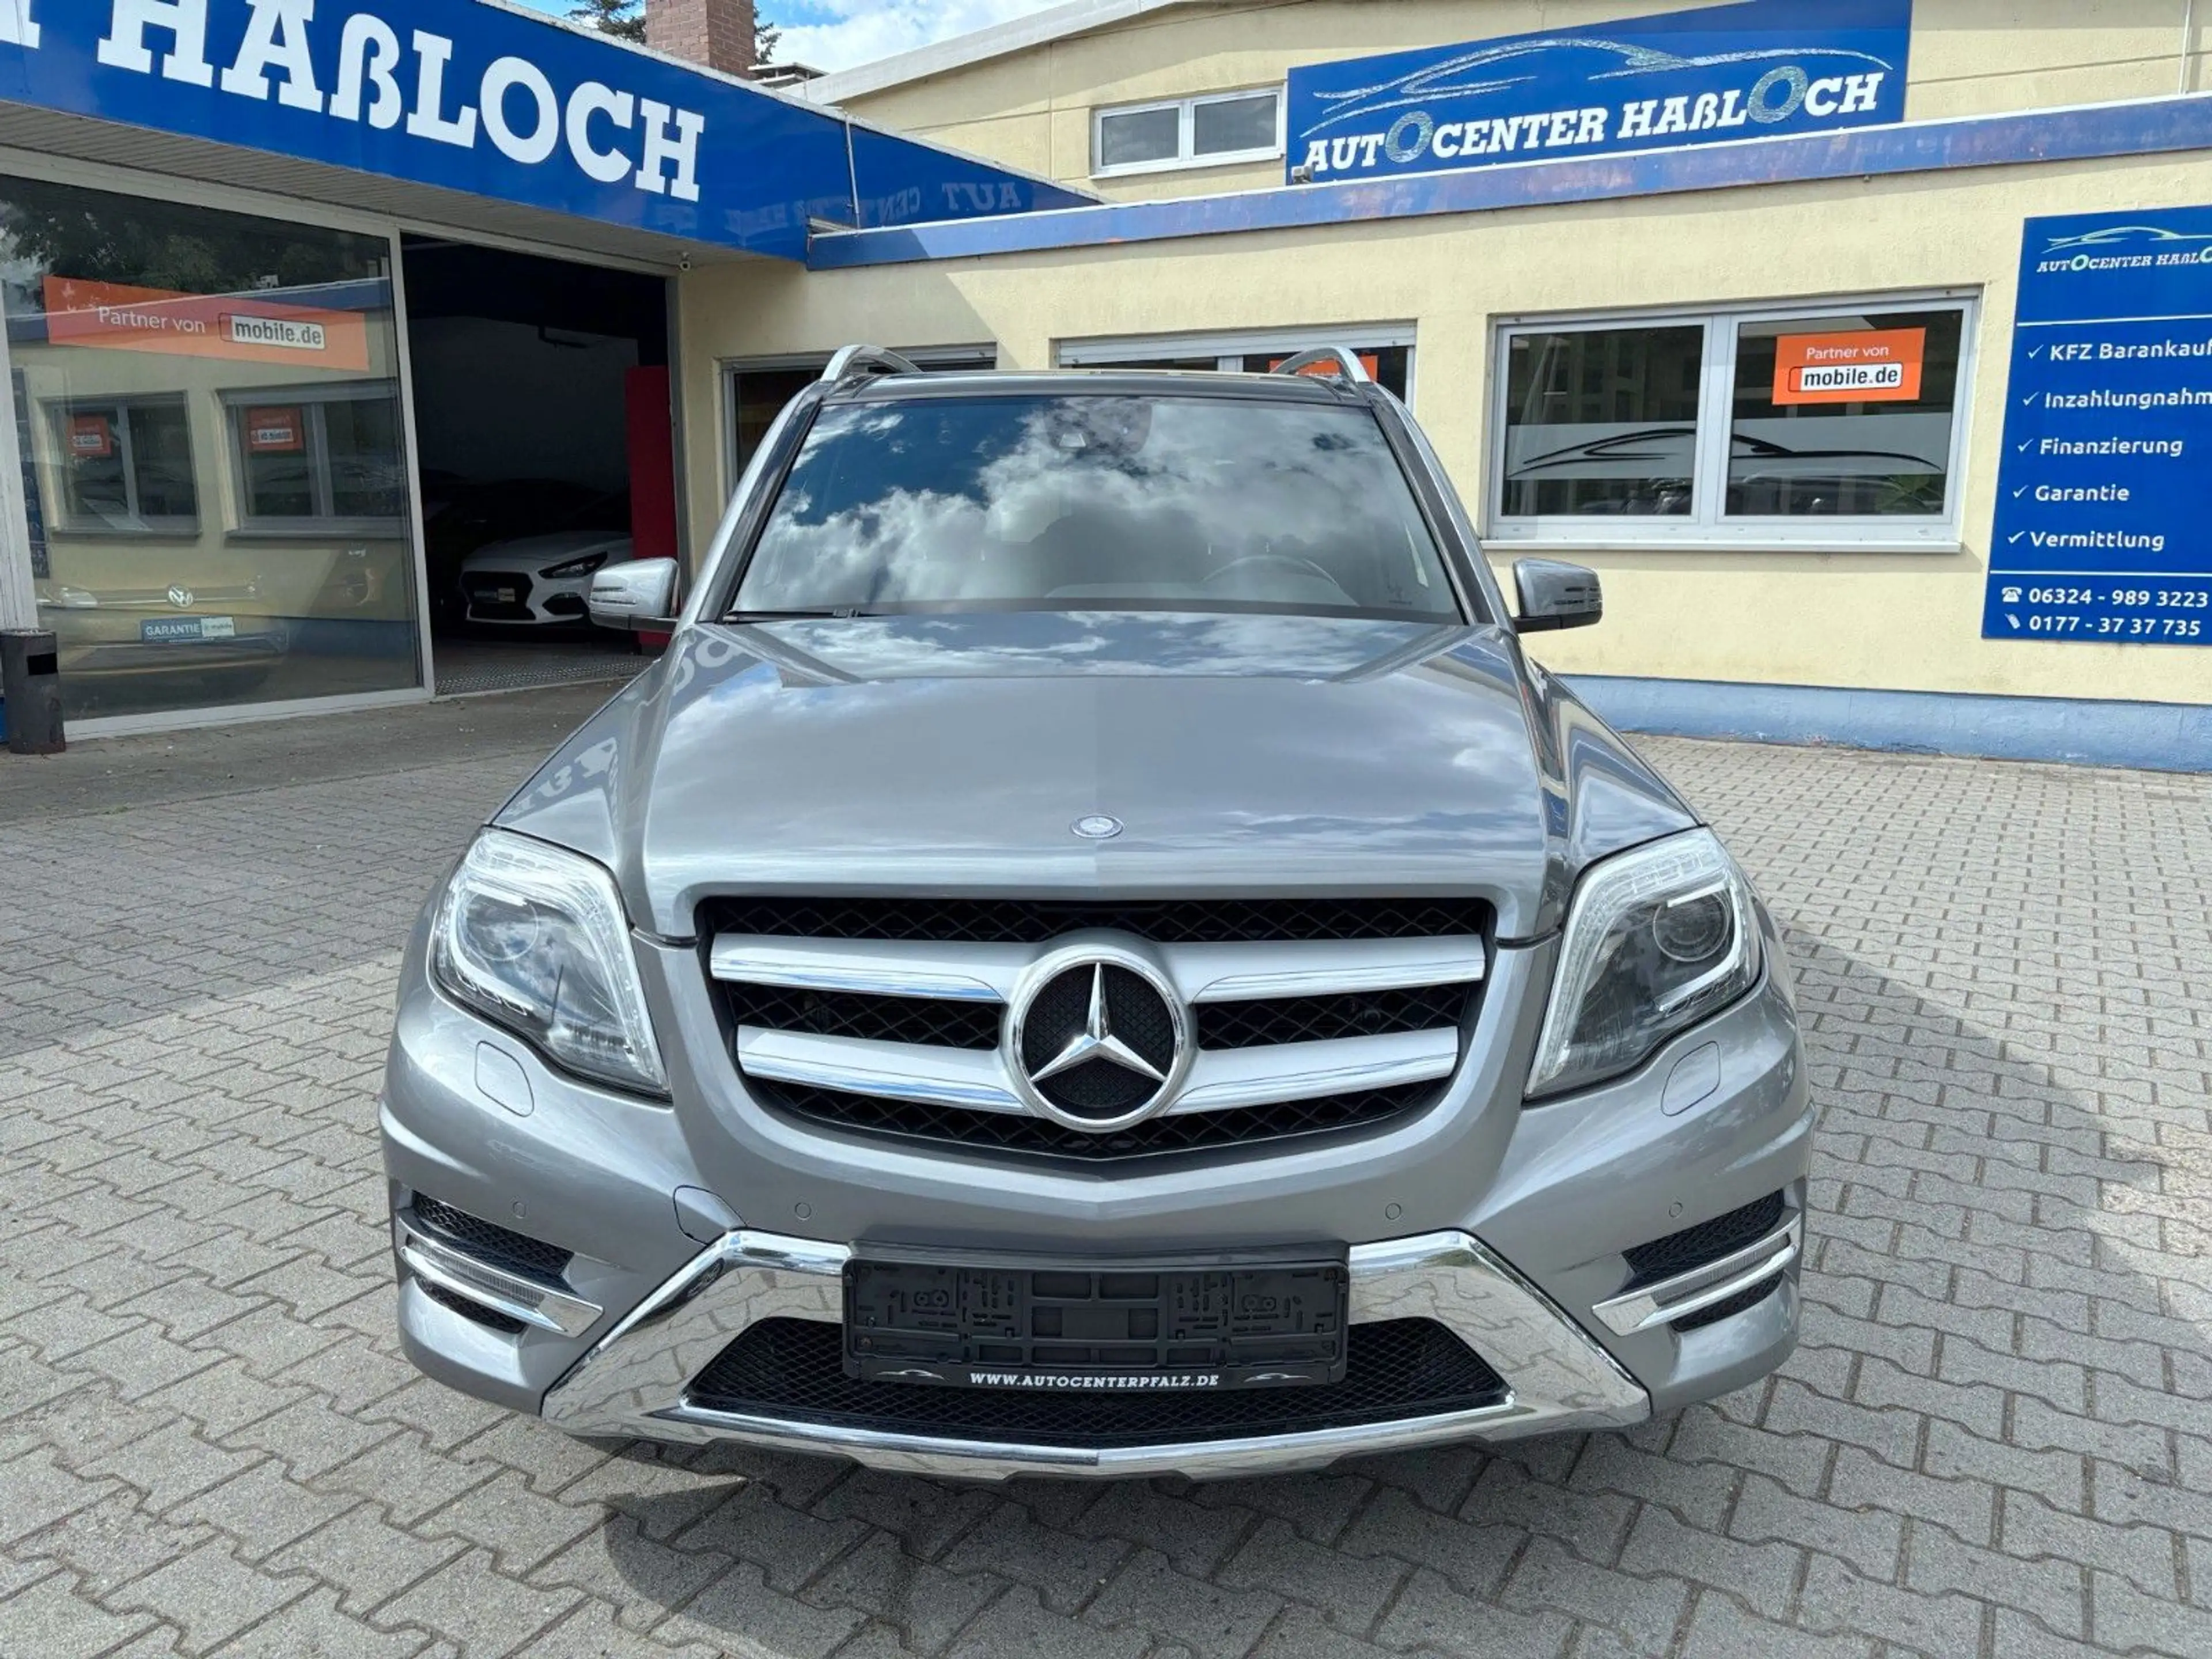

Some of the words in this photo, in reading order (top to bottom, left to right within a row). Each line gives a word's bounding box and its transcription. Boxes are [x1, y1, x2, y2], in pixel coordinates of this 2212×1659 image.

[1304, 111, 1608, 172] AUTOCENTER
[1616, 66, 1884, 139] HAßLOCH
[2036, 254, 2152, 273] AUTOCENTER
[99, 306, 168, 329] Partner
[172, 318, 206, 333] von
[235, 321, 322, 345] mobile.de
[1806, 347, 1859, 360] Partner
[1862, 346, 1889, 357] von
[2050, 344, 2092, 361] KFZ
[1804, 366, 1898, 387] mobile.de
[2040, 437, 2183, 457] Finanzierung
[2035, 484, 2130, 501] Garantie
[2029, 531, 2165, 552] Vermittlung
[2029, 588, 2092, 604] 06324
[2112, 590, 2150, 606] 989
[2156, 592, 2209, 608] 3223
[146, 623, 202, 636] GARANTIE
[2029, 615, 2080, 631] 0177
[2099, 618, 2124, 633] 37
[2130, 619, 2157, 634] 37
[2162, 620, 2201, 636] 735
[969, 1372, 1219, 1388] WWW.AUTOCENTERPFALZ.DE
